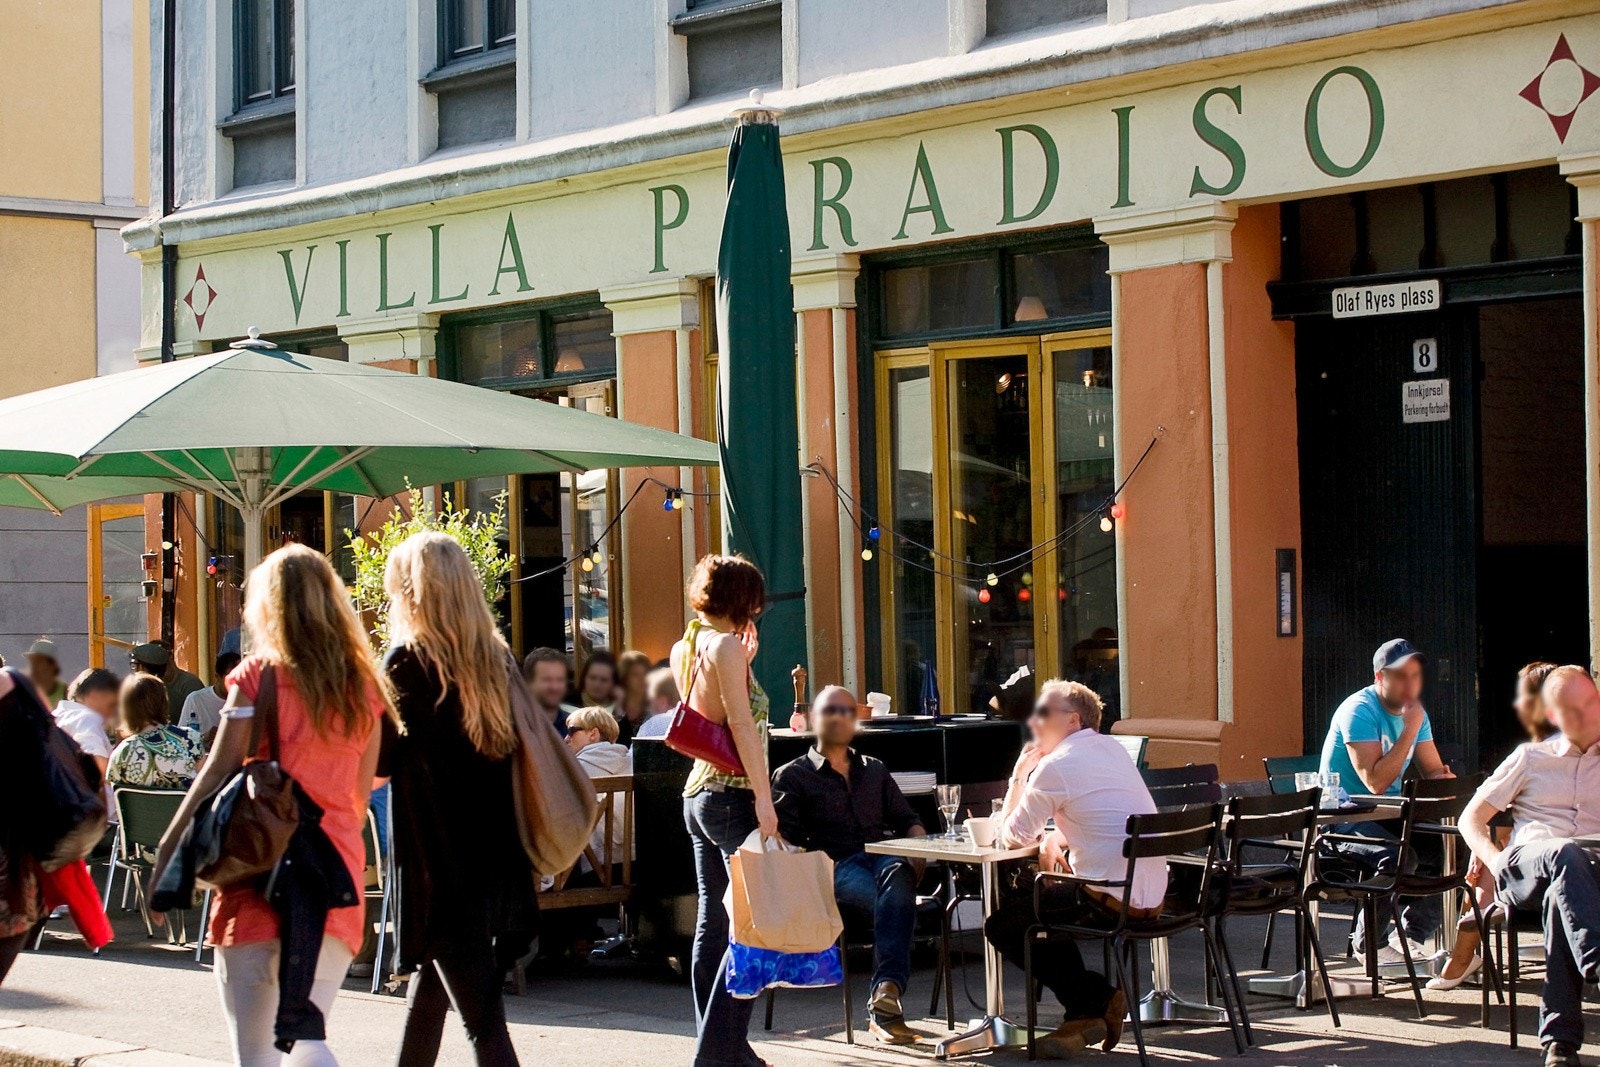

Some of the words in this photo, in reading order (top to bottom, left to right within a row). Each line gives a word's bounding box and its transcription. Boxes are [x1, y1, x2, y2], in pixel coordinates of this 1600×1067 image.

[277, 210, 535, 326] VILLA
[648, 65, 1385, 274] PRADISO
[1336, 291, 1360, 313] Olaf
[1365, 290, 1395, 312] Ryes
[1401, 286, 1434, 310] plass
[1418, 343, 1431, 367] 8
